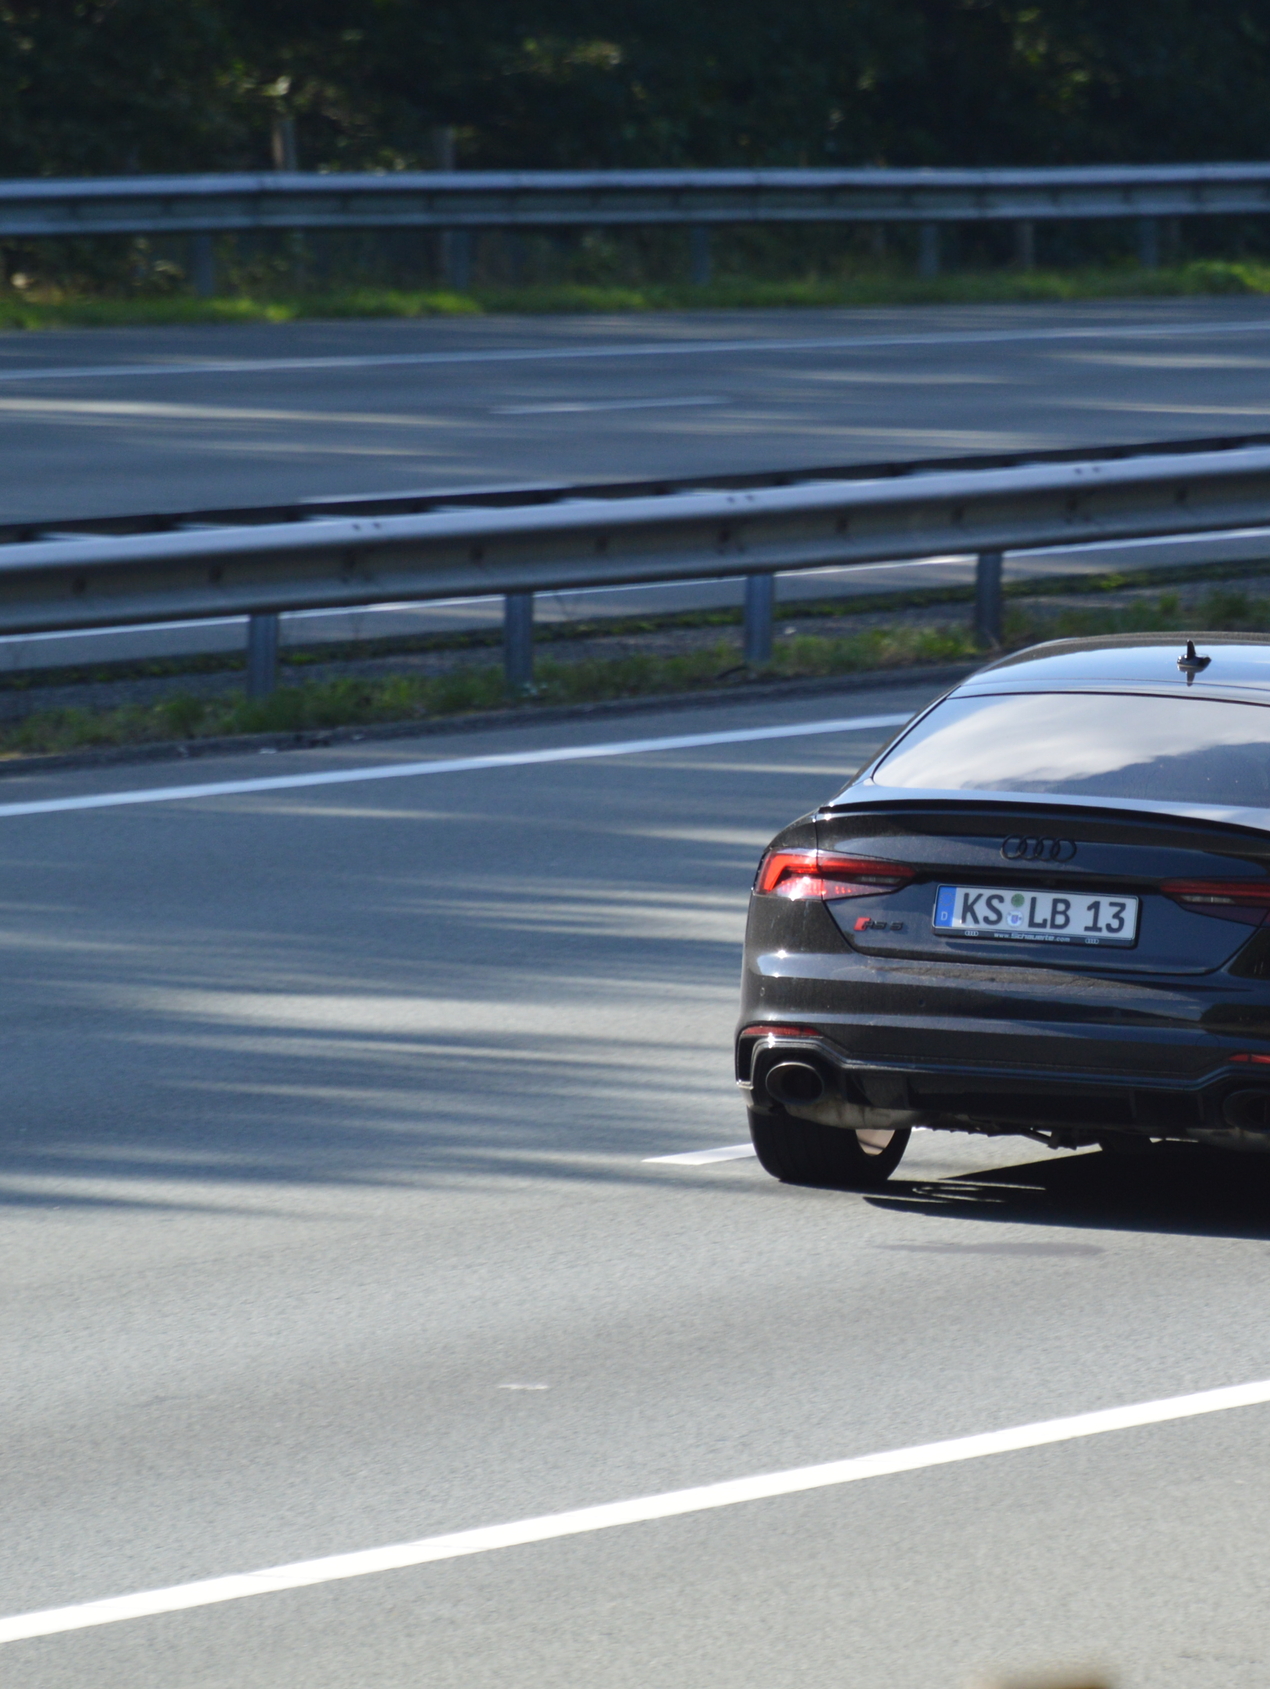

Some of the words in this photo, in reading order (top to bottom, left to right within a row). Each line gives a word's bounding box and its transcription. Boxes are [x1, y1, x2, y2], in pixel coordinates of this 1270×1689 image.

[941, 911, 948, 921] D
[961, 892, 1005, 926] KS
[1027, 896, 1071, 930] LB
[1083, 900, 1127, 934] 13
